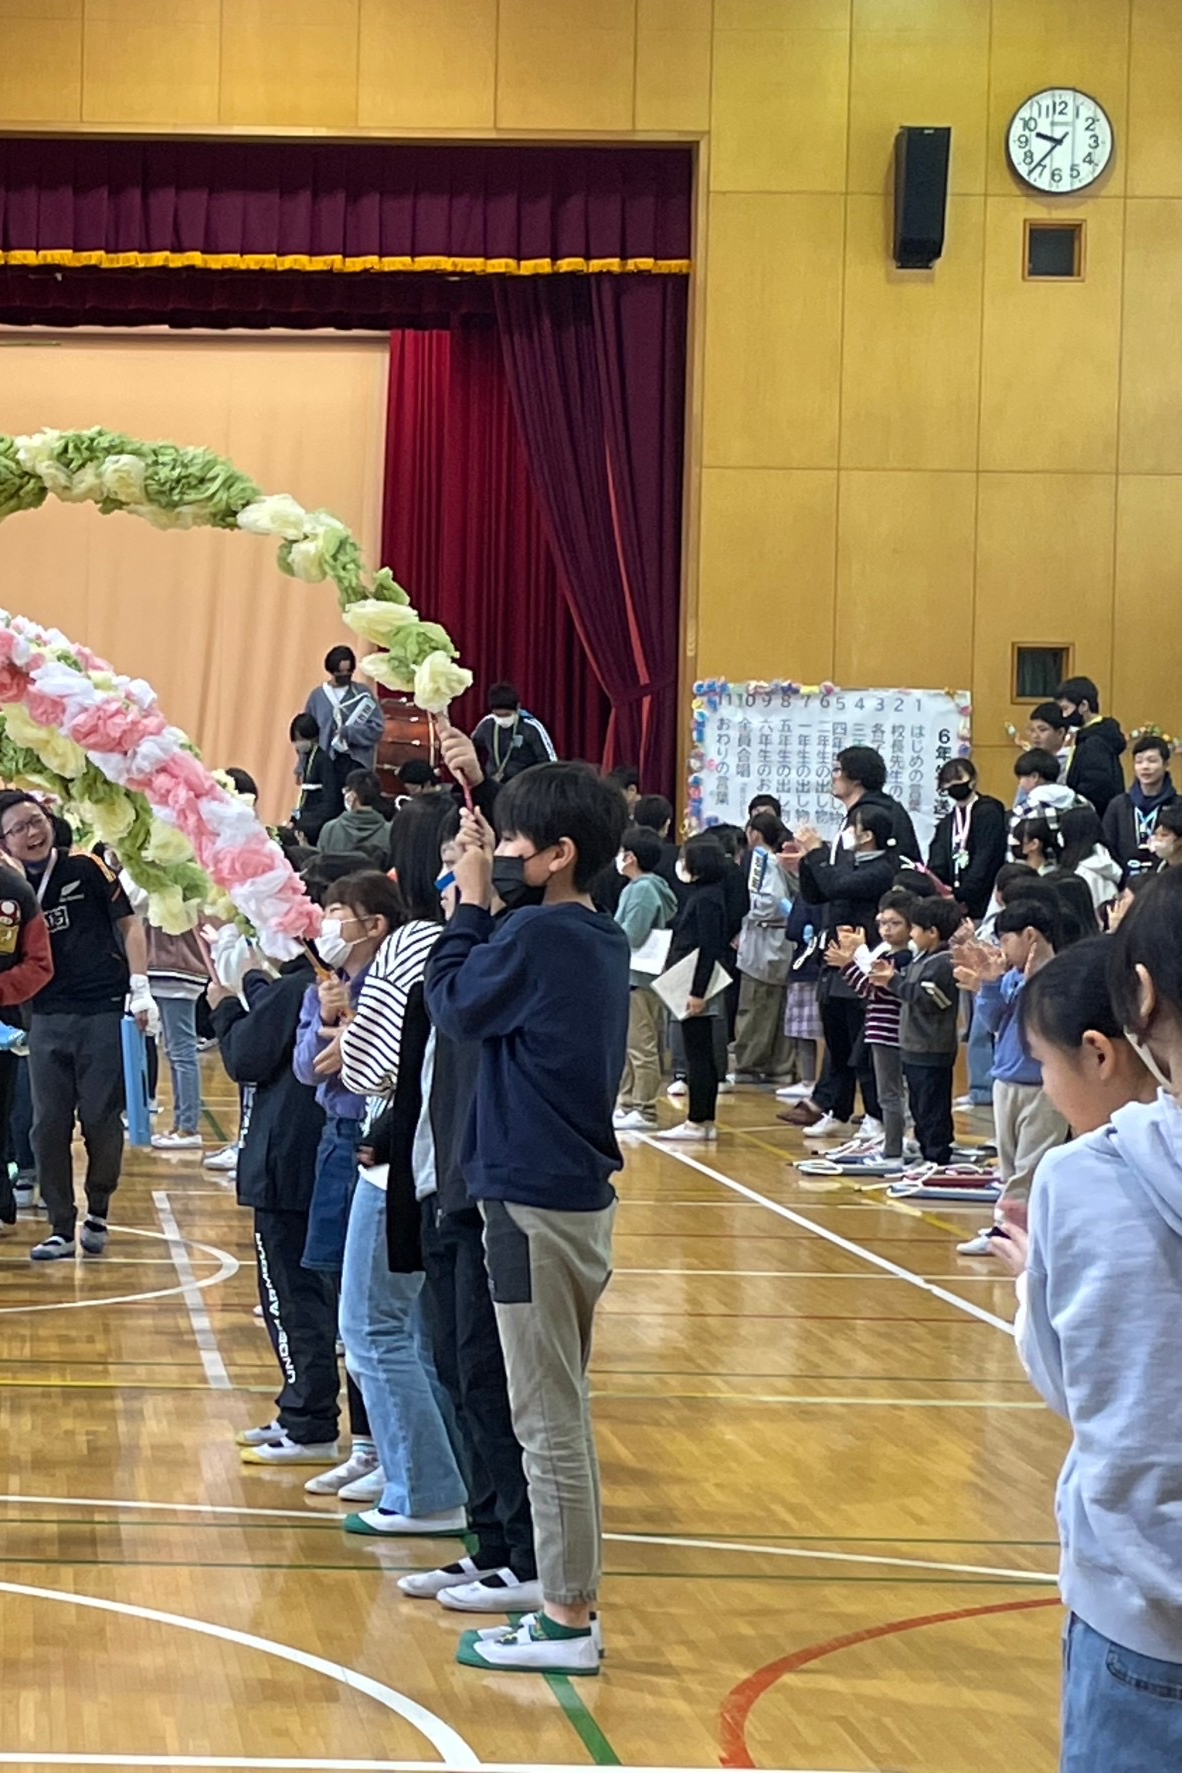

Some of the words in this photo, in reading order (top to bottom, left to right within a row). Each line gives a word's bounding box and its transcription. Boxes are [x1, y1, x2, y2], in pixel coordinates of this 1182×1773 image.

[1036, 101, 1050, 119] 11
[1052, 101, 1068, 116] 12
[1019, 117, 1038, 132] 10
[1084, 117, 1096, 132] 2
[1018, 134, 1029, 149] 9
[1088, 134, 1100, 149] 3
[1023, 149, 1034, 165] 8
[1082, 152, 1095, 165] 4
[1037, 162, 1047, 179] 7
[1051, 168, 1062, 183] 6
[1069, 164, 1080, 179] 5
[738, 693, 756, 708] 10
[761, 694, 772, 708] 9
[781, 693, 791, 709] 8
[800, 694, 811, 709] 7
[820, 693, 830, 709] 6
[835, 696, 846, 711] 5
[854, 697, 865, 711] 4
[875, 697, 885, 712] 3
[893, 697, 904, 712] 2
[736, 717, 752, 778] 全員合唱
[715, 717, 731, 805] おわりの言葉
[908, 724, 925, 812] はじめの言葉
[795, 723, 813, 823] 一年生の出し物
[815, 721, 831, 825] 二年生の出し物
[274, 1319, 296, 1384] UNDER
